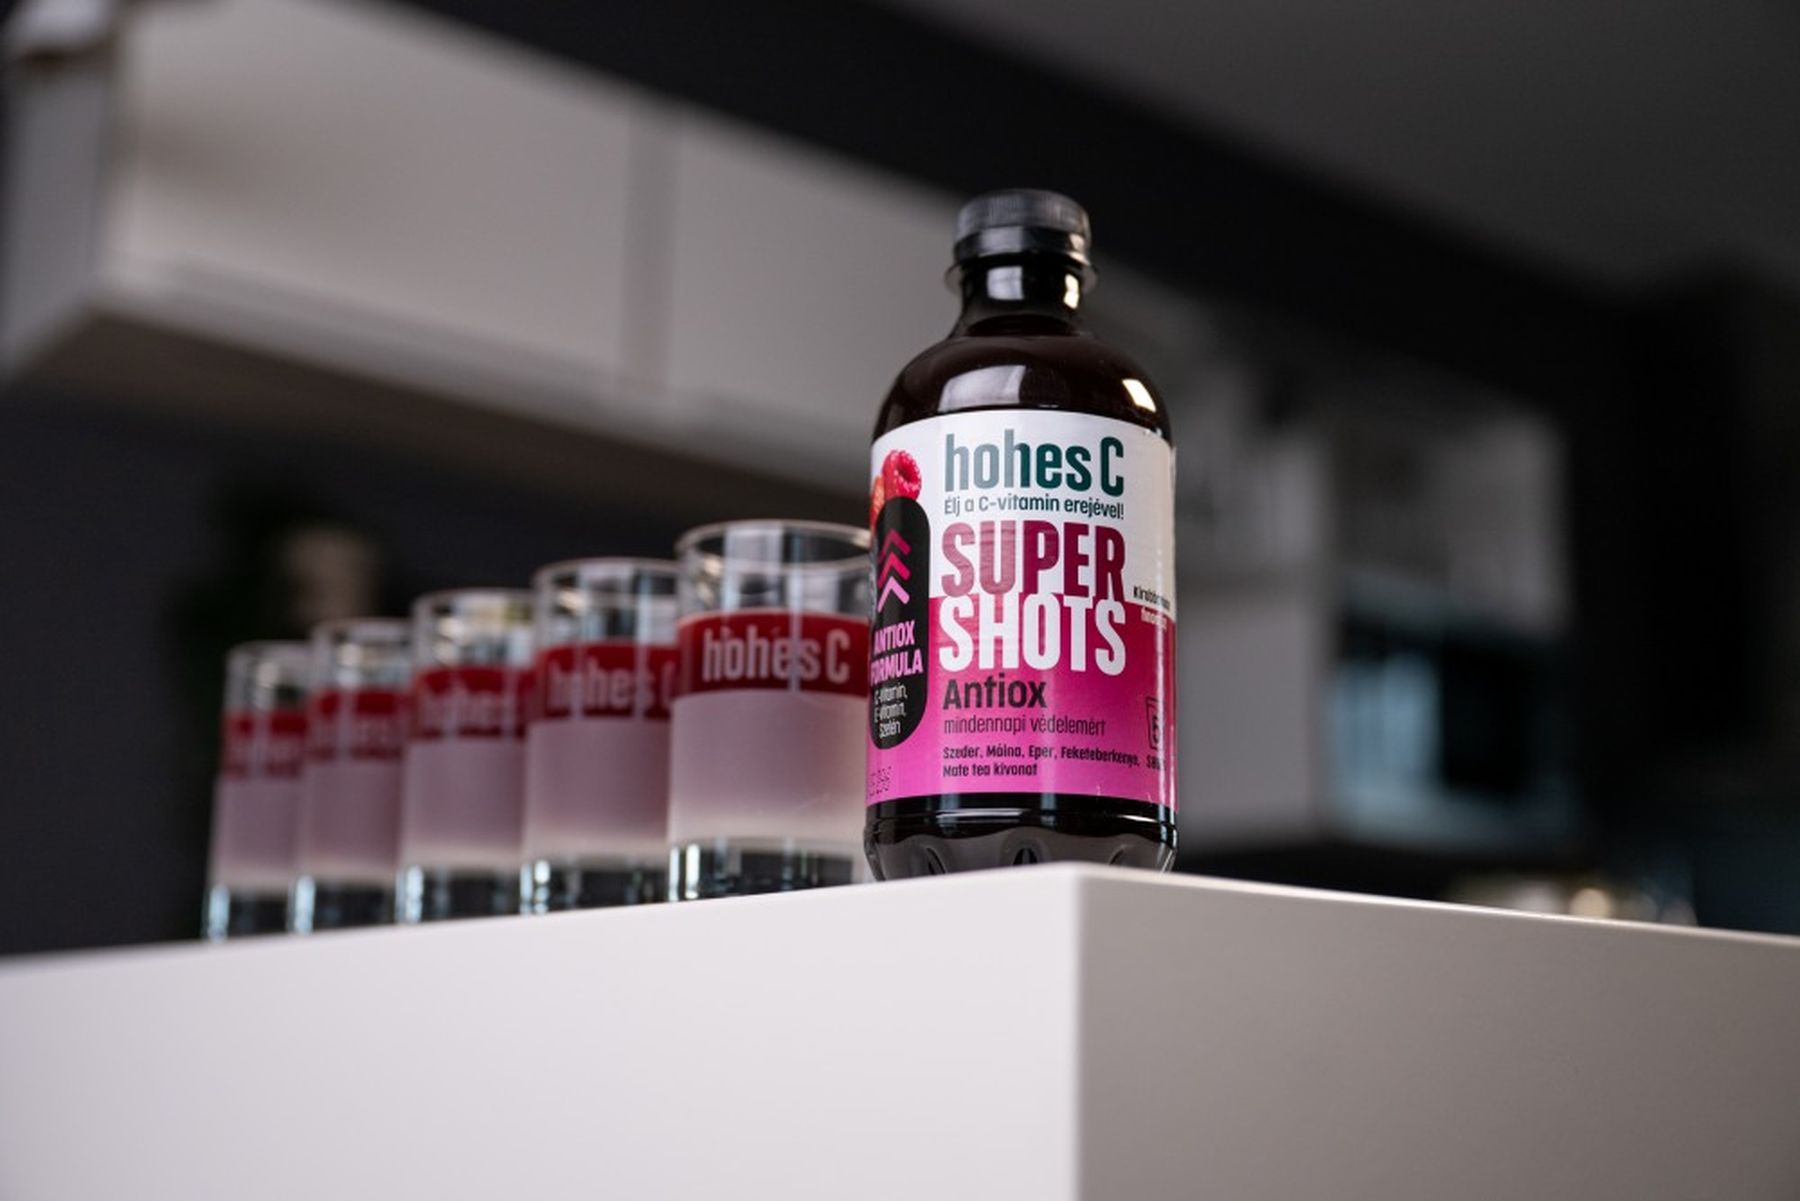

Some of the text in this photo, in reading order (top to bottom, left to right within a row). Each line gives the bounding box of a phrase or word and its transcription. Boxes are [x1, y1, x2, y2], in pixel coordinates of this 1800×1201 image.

[944, 428, 1125, 497] hohes C
[944, 493, 1125, 520] Élj a C-vitamin erejével!
[941, 519, 1126, 602] SUPER
[873, 620, 916, 657] ANTIOX
[939, 592, 1126, 676] SHOTS
[702, 624, 850, 684] hohes C
[871, 648, 924, 687] FORMULA
[942, 672, 1048, 710] Antiox
[944, 714, 1106, 736] mindennapi védelemért
[972, 763, 990, 776] tea
[1029, 745, 1058, 761] Eper,
